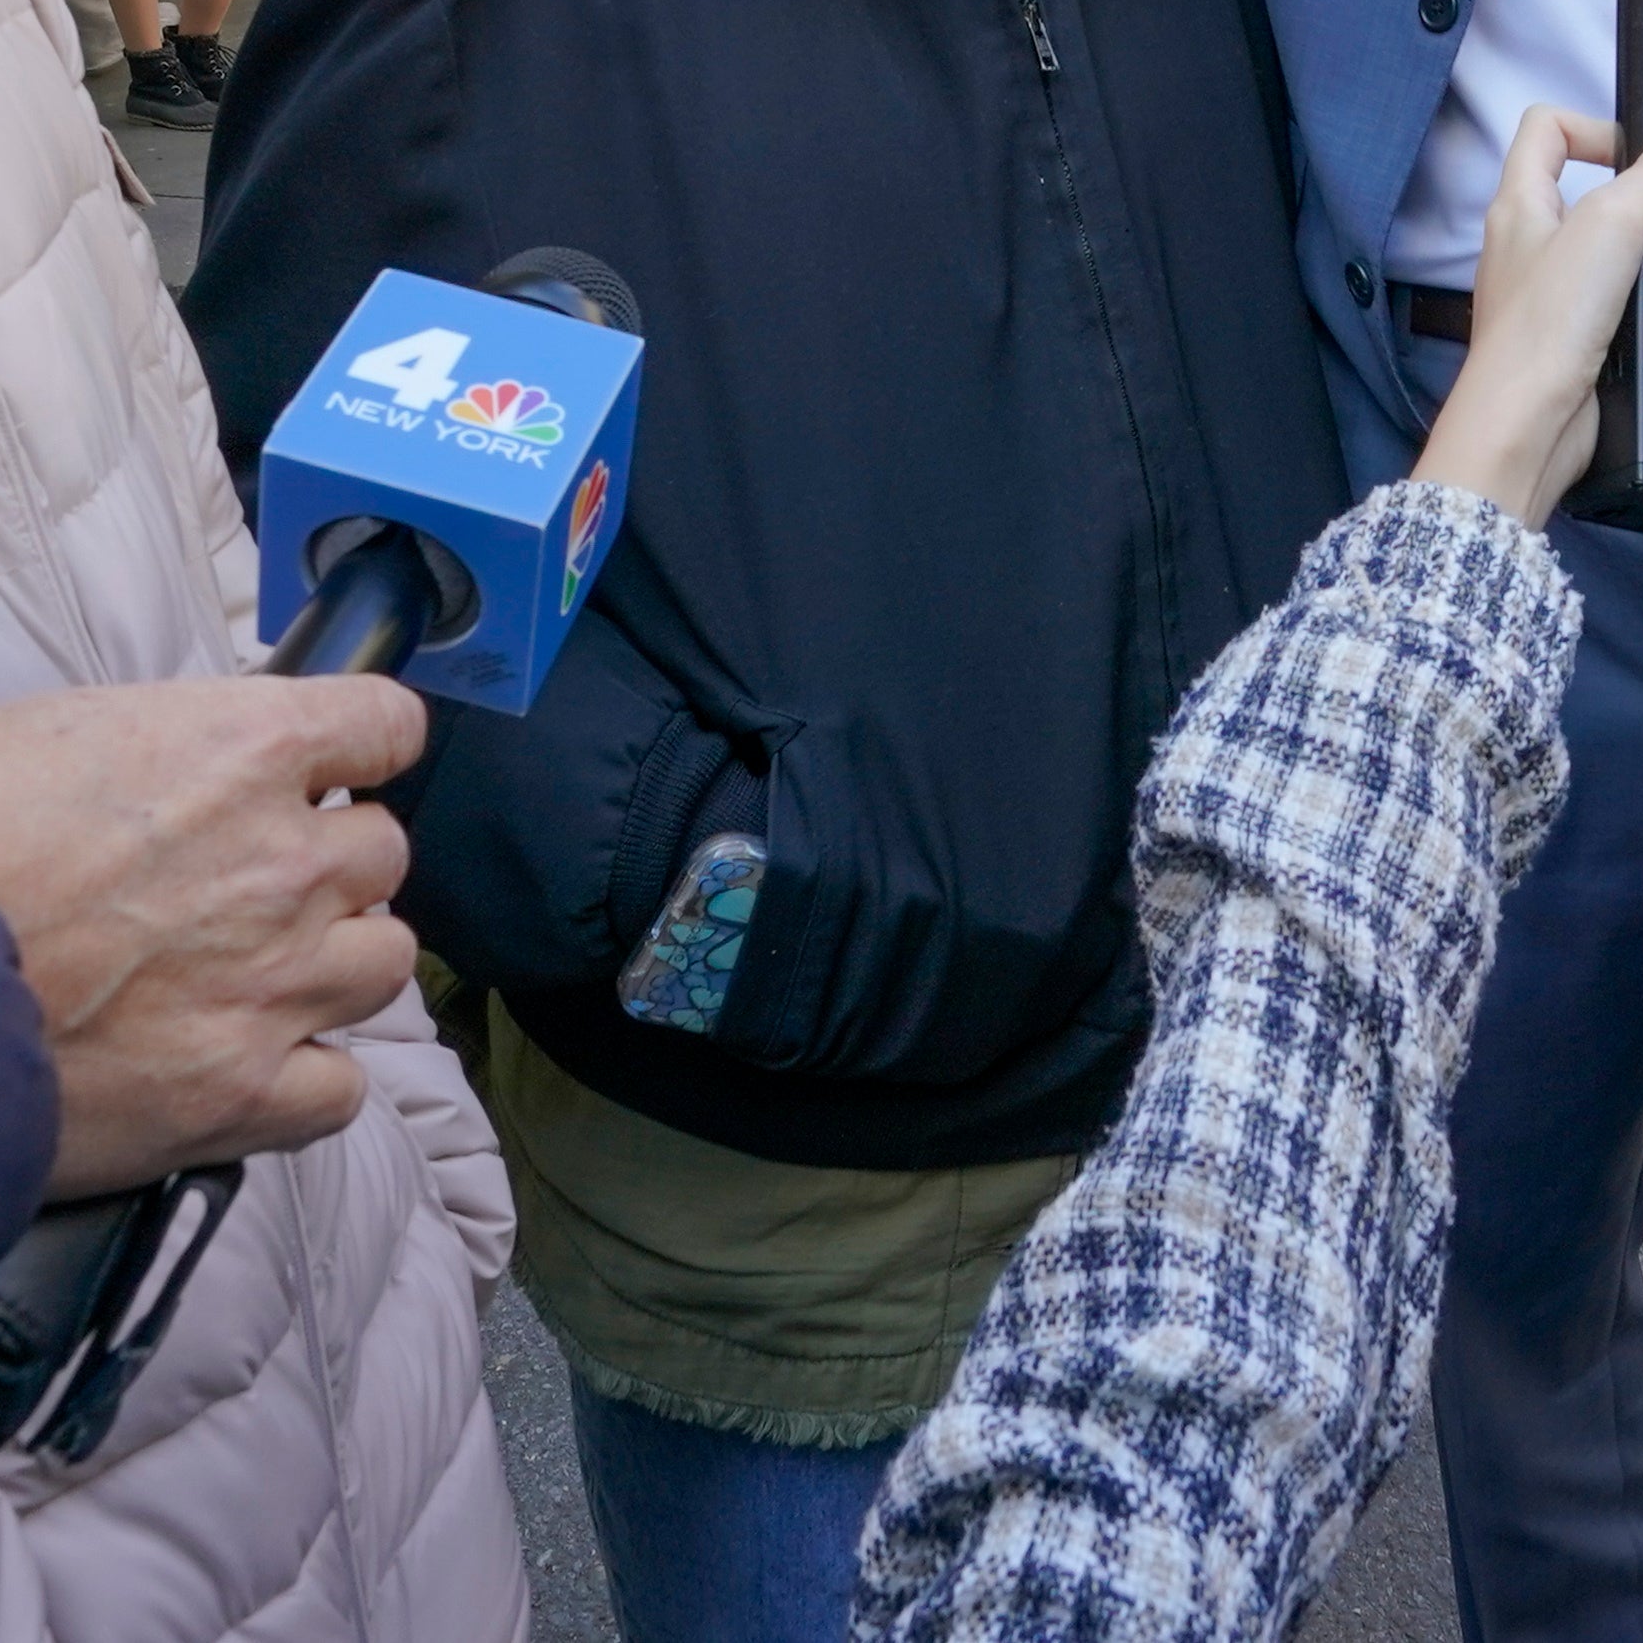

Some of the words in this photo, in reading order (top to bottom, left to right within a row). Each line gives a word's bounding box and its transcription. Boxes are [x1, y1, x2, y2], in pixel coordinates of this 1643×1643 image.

[347, 327, 471, 411] 4
[325, 390, 425, 433] NEW
[434, 421, 552, 470] YORK
